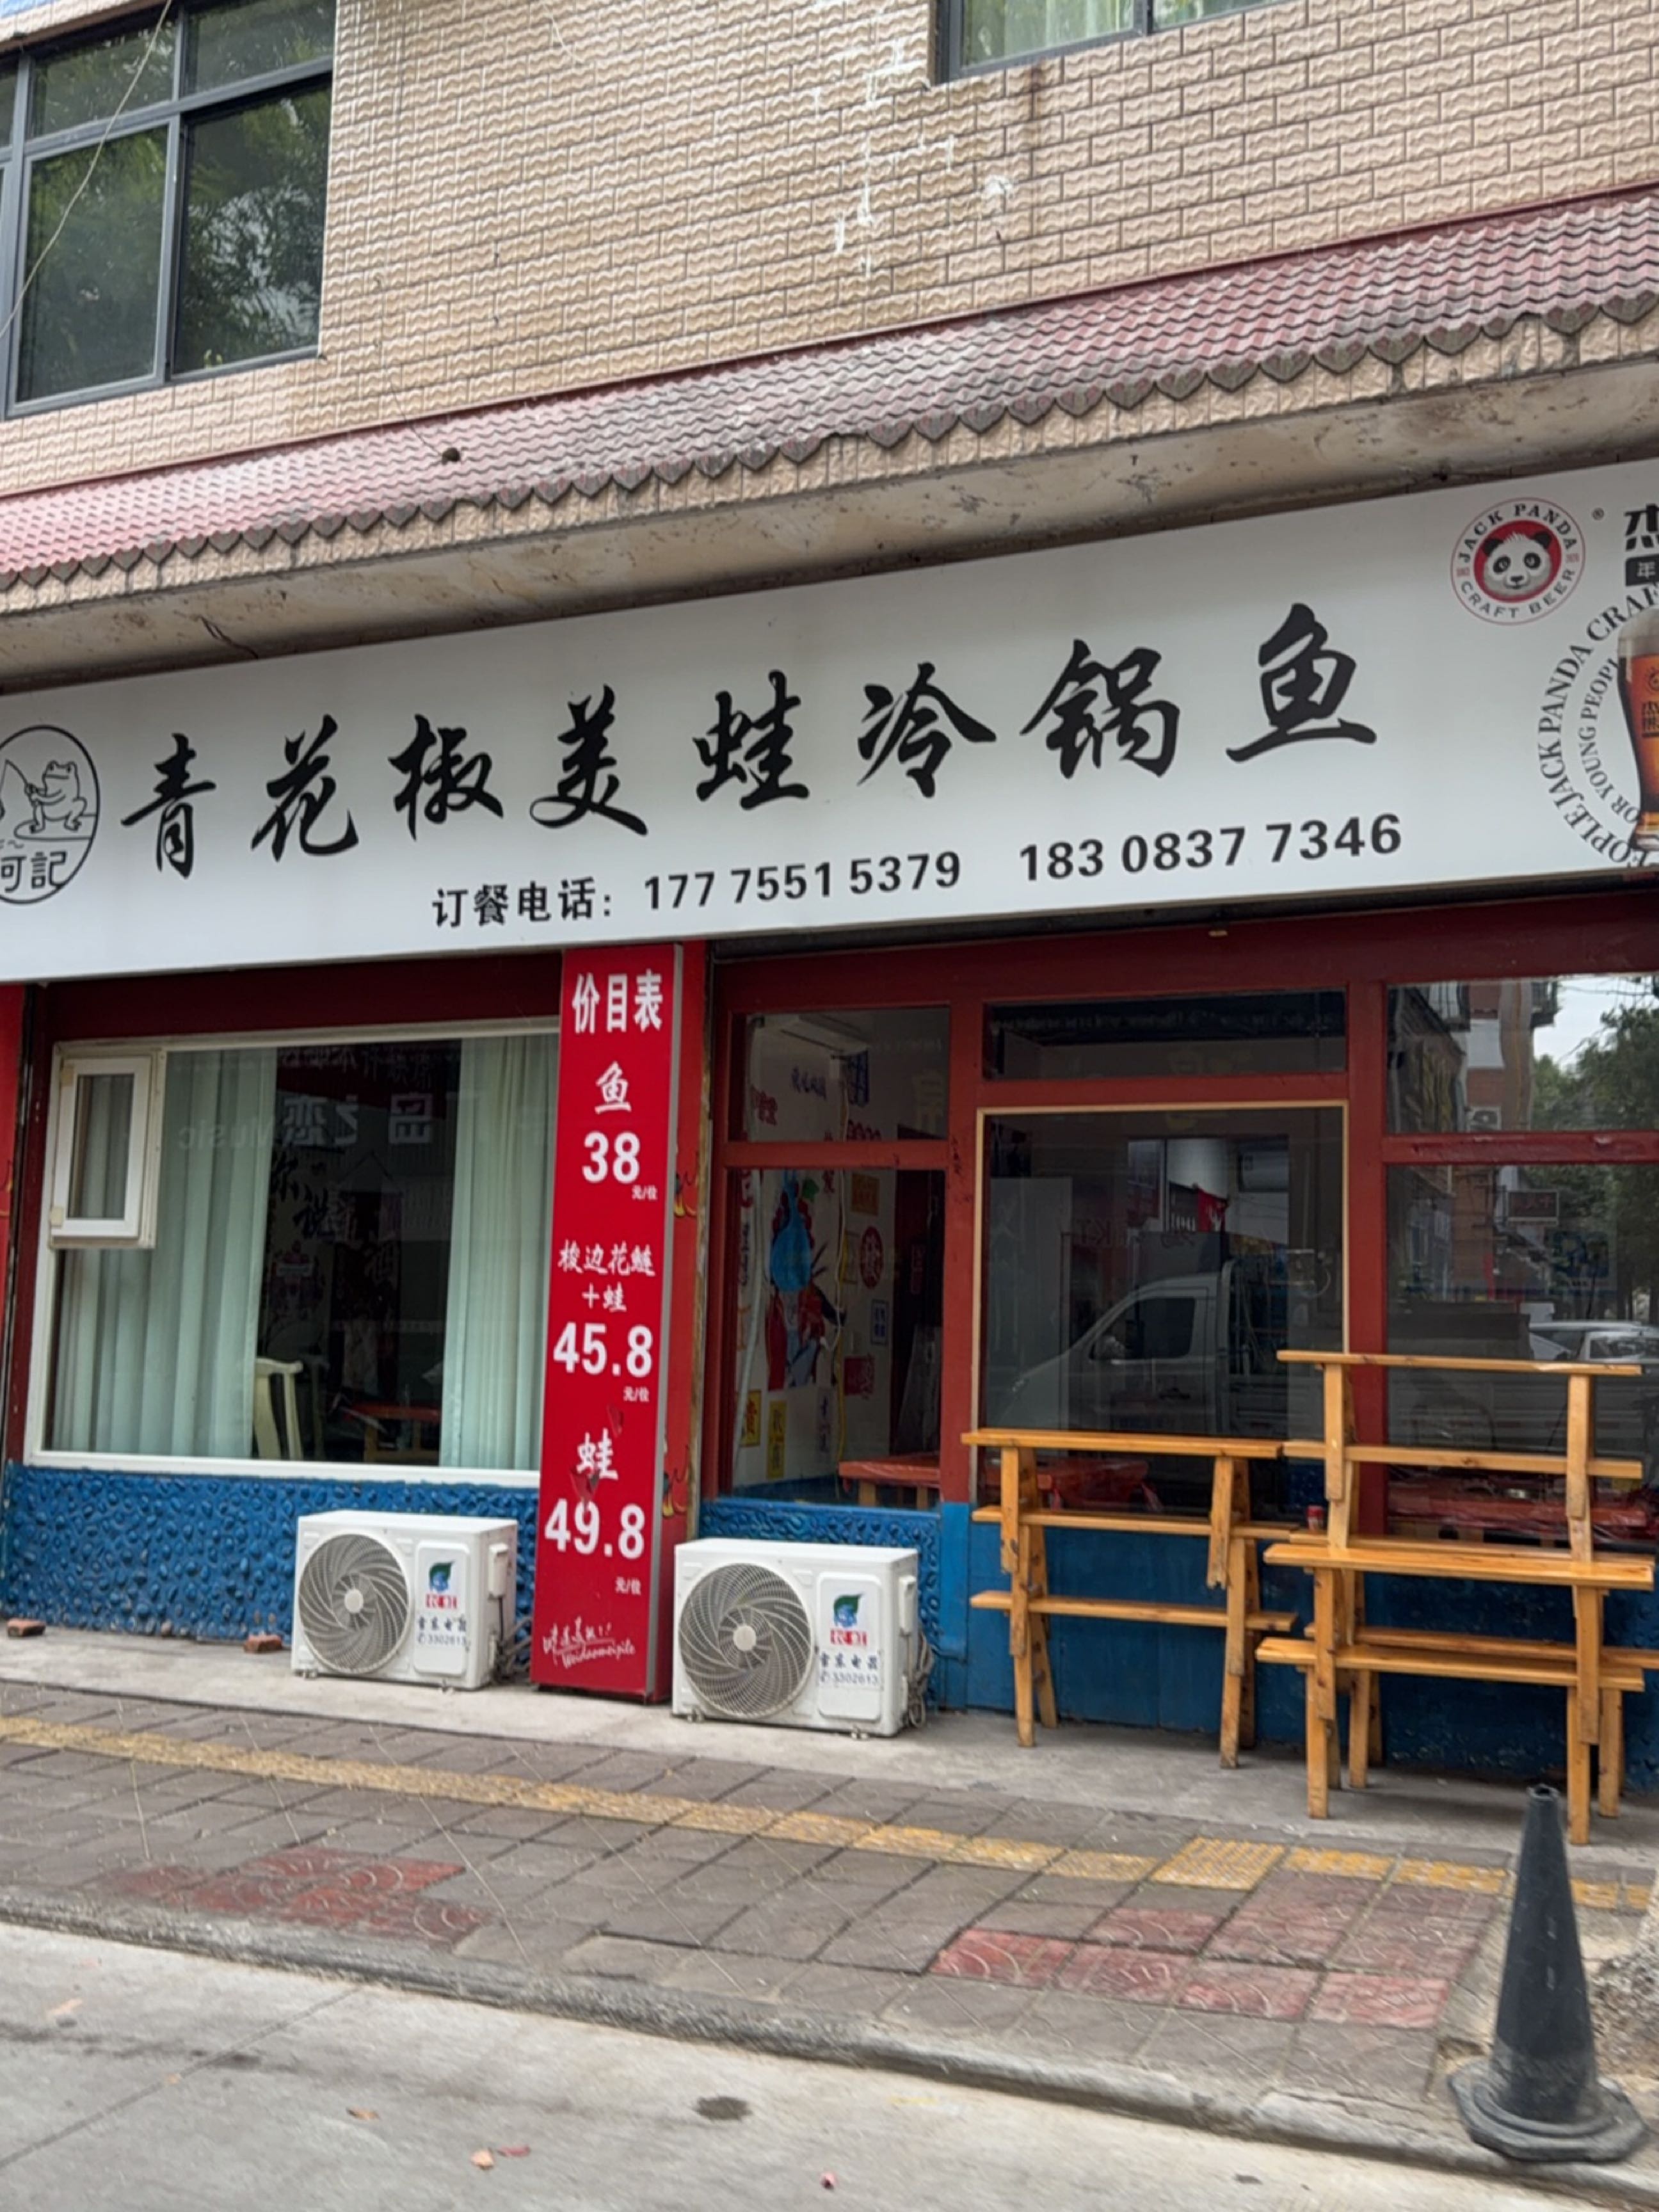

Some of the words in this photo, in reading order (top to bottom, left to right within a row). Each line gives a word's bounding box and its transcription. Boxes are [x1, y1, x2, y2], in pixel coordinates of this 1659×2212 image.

[1459, 511, 1503, 563] JACK
[1514, 503, 1577, 549] PANDA
[1461, 581, 1519, 619] CRAFT
[1529, 569, 1575, 614] BEER
[1538, 645, 1593, 733] PANDA
[1578, 726, 1614, 800] YOUNG
[433, 876, 611, 927] 订餐电话：
[645, 872, 715, 910] 177
[731, 862, 831, 903] 7551
[849, 851, 960, 895] 5379
[1020, 838, 1104, 881] 183
[1121, 827, 1246, 874] 0837
[1265, 813, 1402, 863] 7346
[572, 968, 663, 1034] 价目表
[595, 1061, 632, 1115] 鱼
[582, 1130, 641, 1184] 38
[553, 1321, 653, 1378] 45.8
[577, 1428, 618, 1480] 蛙
[545, 1498, 646, 1560] 49.8
